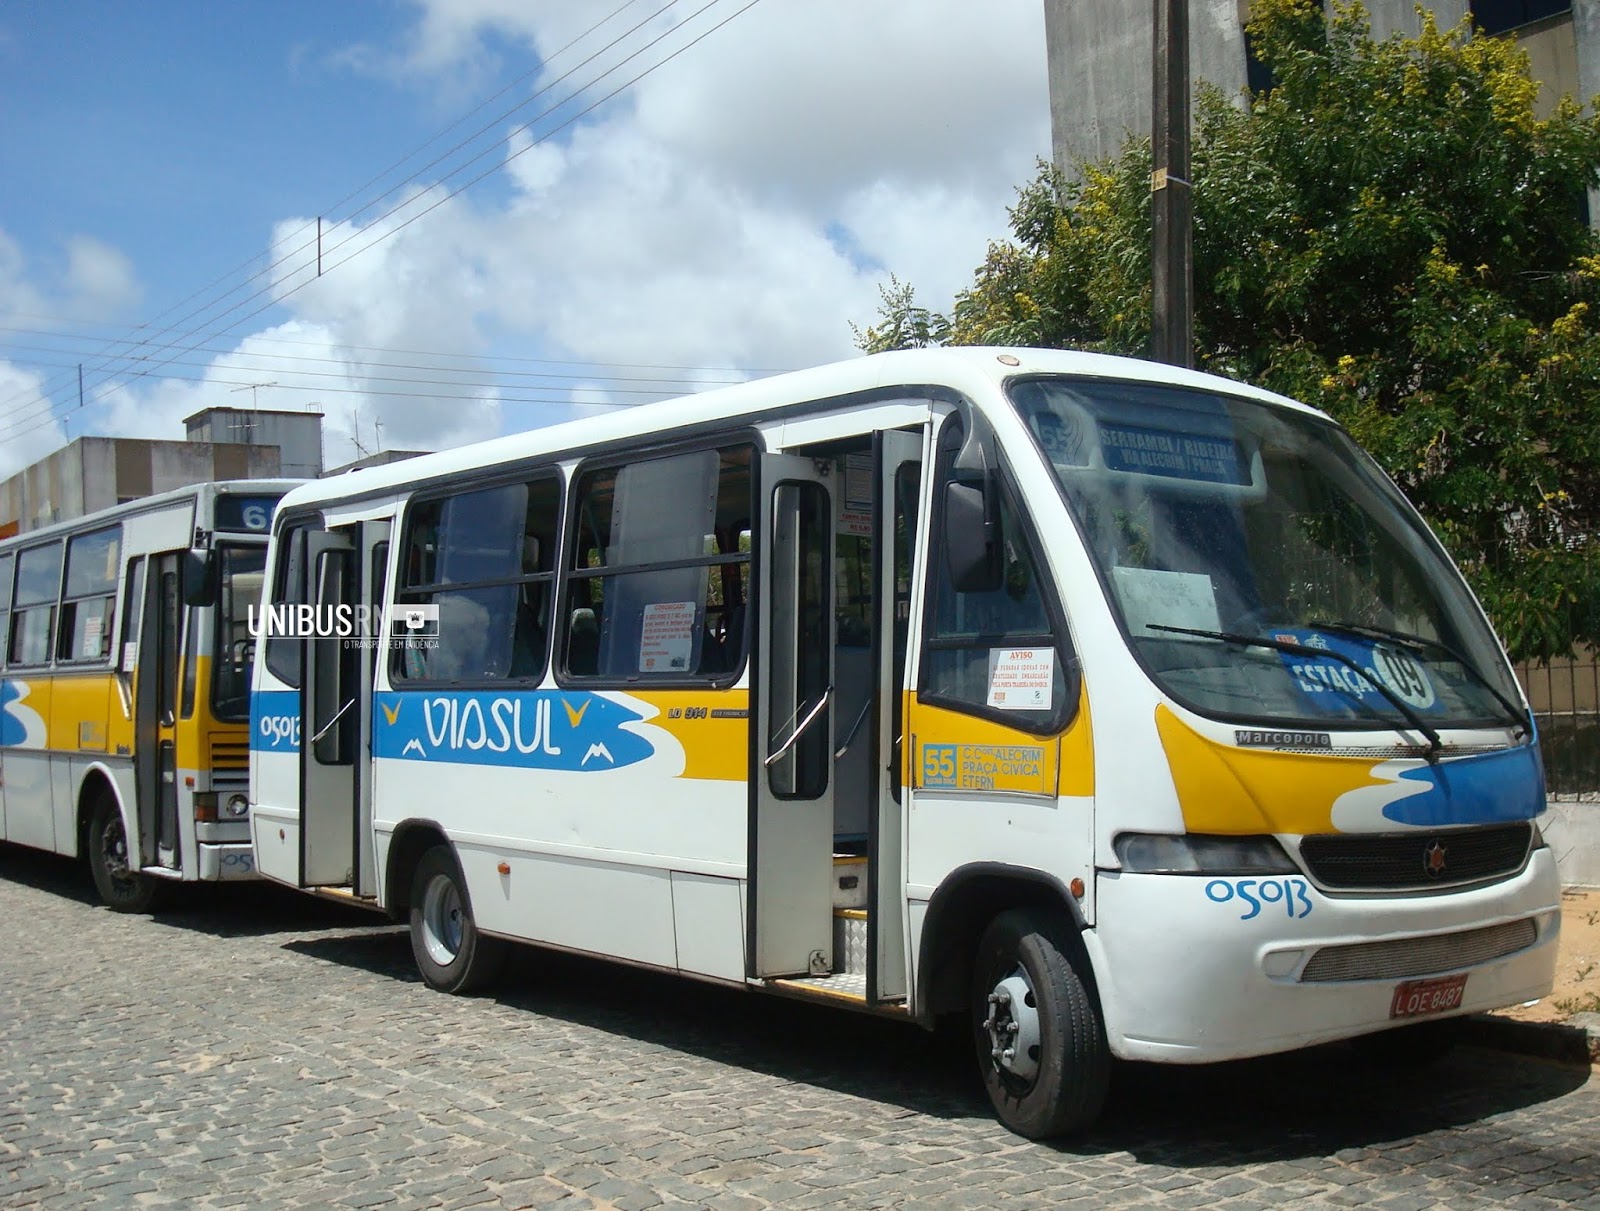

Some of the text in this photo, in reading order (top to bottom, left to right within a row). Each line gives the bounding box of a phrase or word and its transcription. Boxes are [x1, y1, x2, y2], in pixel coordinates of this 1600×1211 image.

[1101, 429, 1172, 452] SERRAMBI
[243, 505, 275, 529] 6
[1010, 651, 1033, 660] AVISO
[668, 708, 681, 718] LO
[685, 707, 707, 719] 914
[424, 698, 560, 754] VIASUL
[1239, 730, 1330, 745] Marcopolo
[925, 748, 956, 778] 55
[995, 748, 1041, 762] ALECRIM
[963, 761, 1040, 776] PRAÇA CIVICA
[963, 775, 995, 789] ETFRN
[1205, 879, 1313, 920] 05013
[1395, 986, 1463, 1015] LOE 8487
